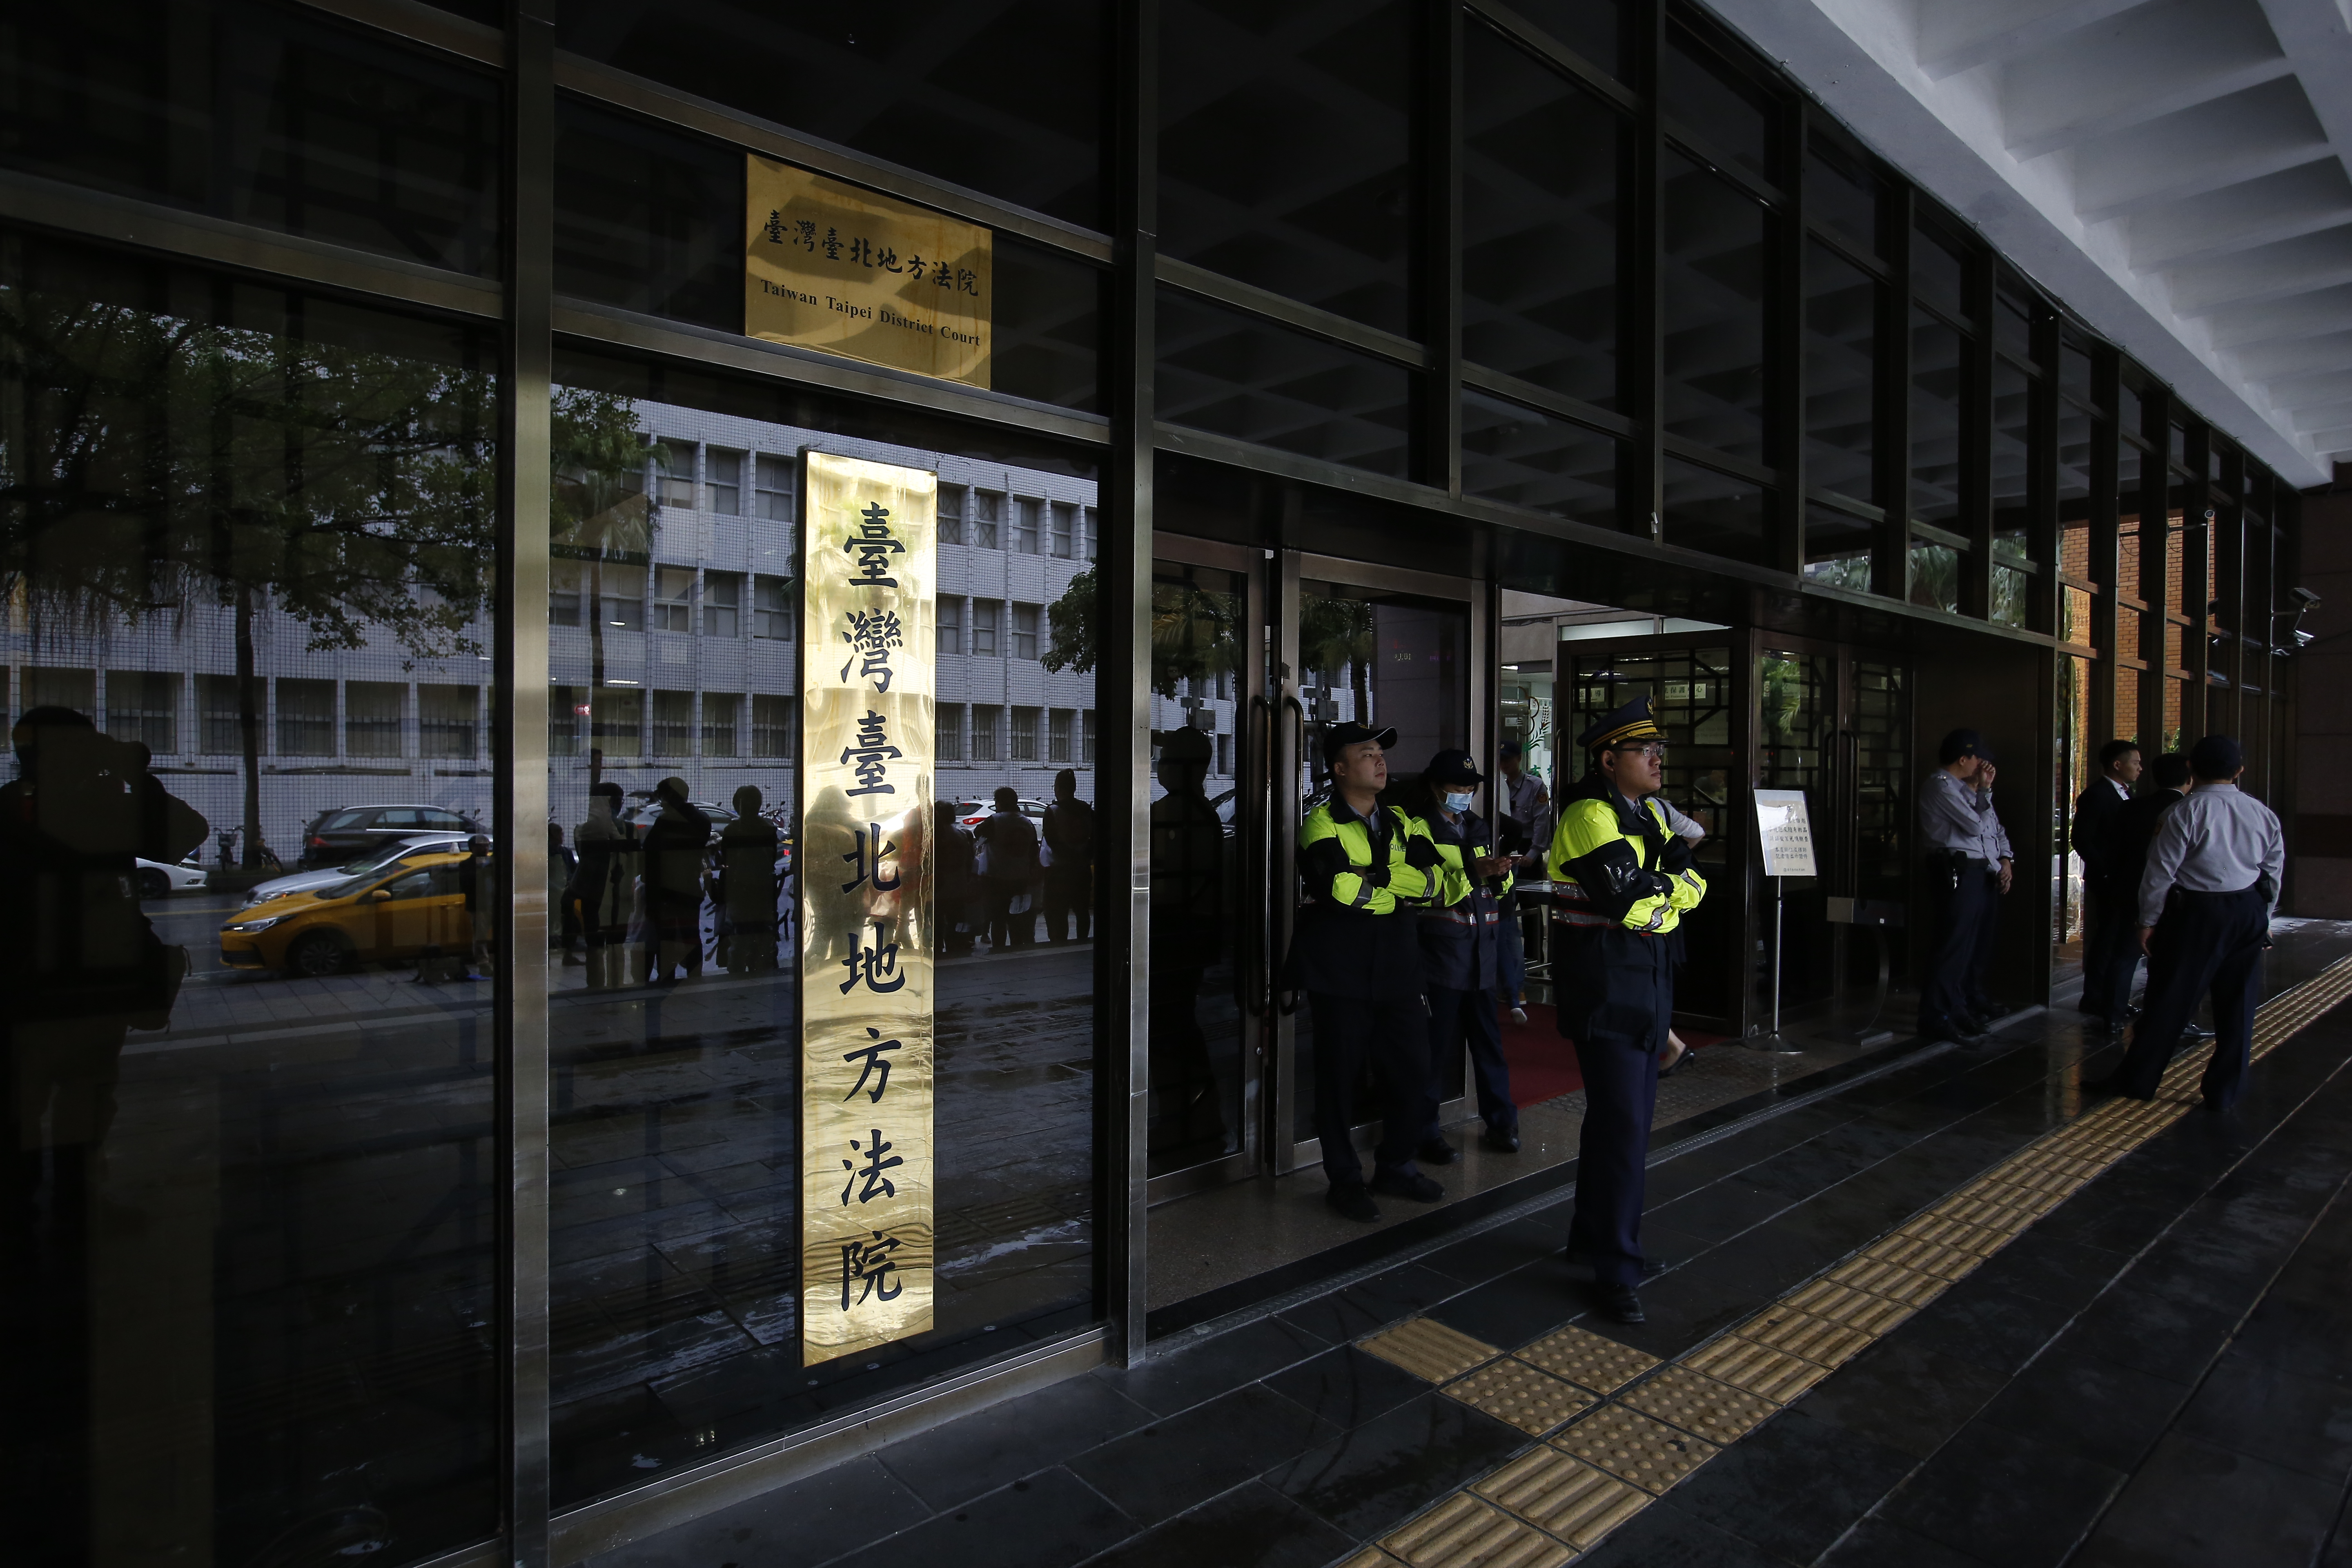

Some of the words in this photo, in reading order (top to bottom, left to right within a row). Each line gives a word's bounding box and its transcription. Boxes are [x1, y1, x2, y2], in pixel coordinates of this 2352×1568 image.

[764, 209, 979, 297] 臺灣臺北地方法院
[761, 279, 817, 306] Taiwan
[826, 296, 872, 319] Taipei
[880, 309, 933, 335] District
[940, 326, 980, 347] Court
[840, 501, 906, 1312] 臺灣臺北地方法院
